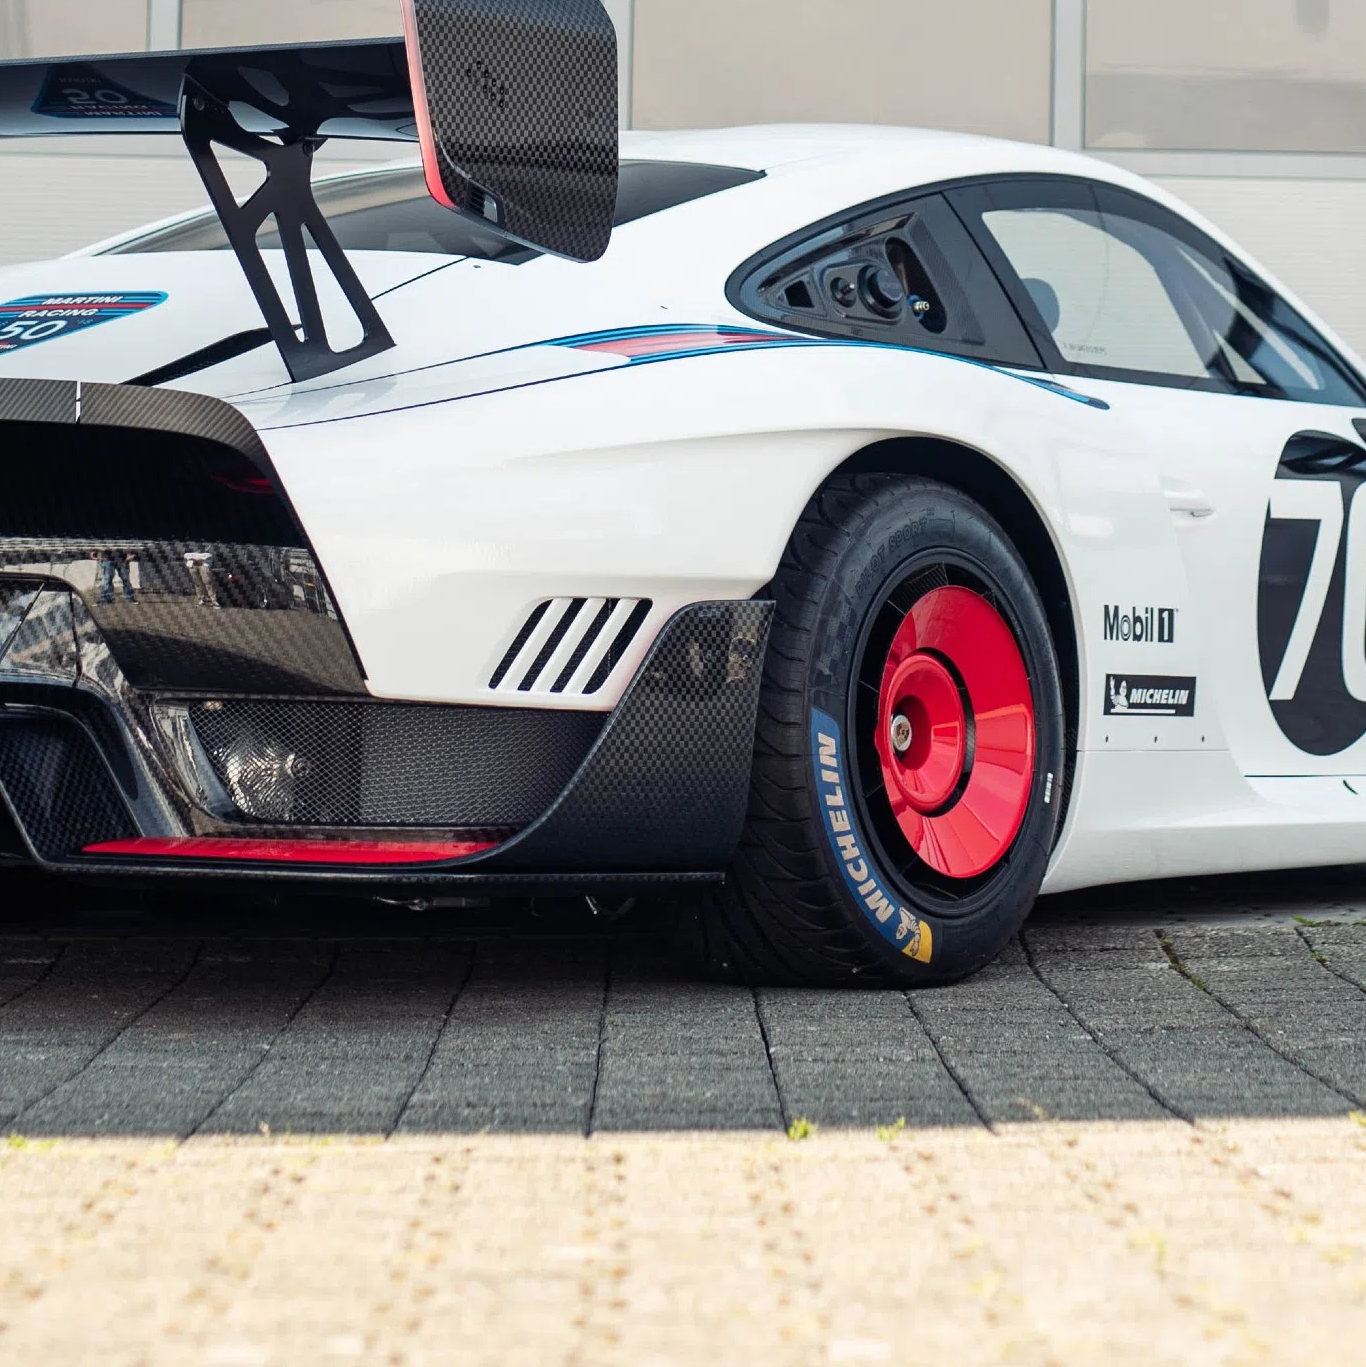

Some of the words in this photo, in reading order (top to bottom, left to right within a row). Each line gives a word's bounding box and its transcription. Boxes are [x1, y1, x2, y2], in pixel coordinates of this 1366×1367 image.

[18, 309, 99, 318] RACING
[41, 296, 124, 305] MARTINI
[855, 544, 885, 600] PILOT
[888, 516, 928, 553] SPORT
[1104, 604, 1154, 642] Mobil
[1129, 688, 1190, 705] MICHELIN
[818, 731, 896, 924] MICHELIN
